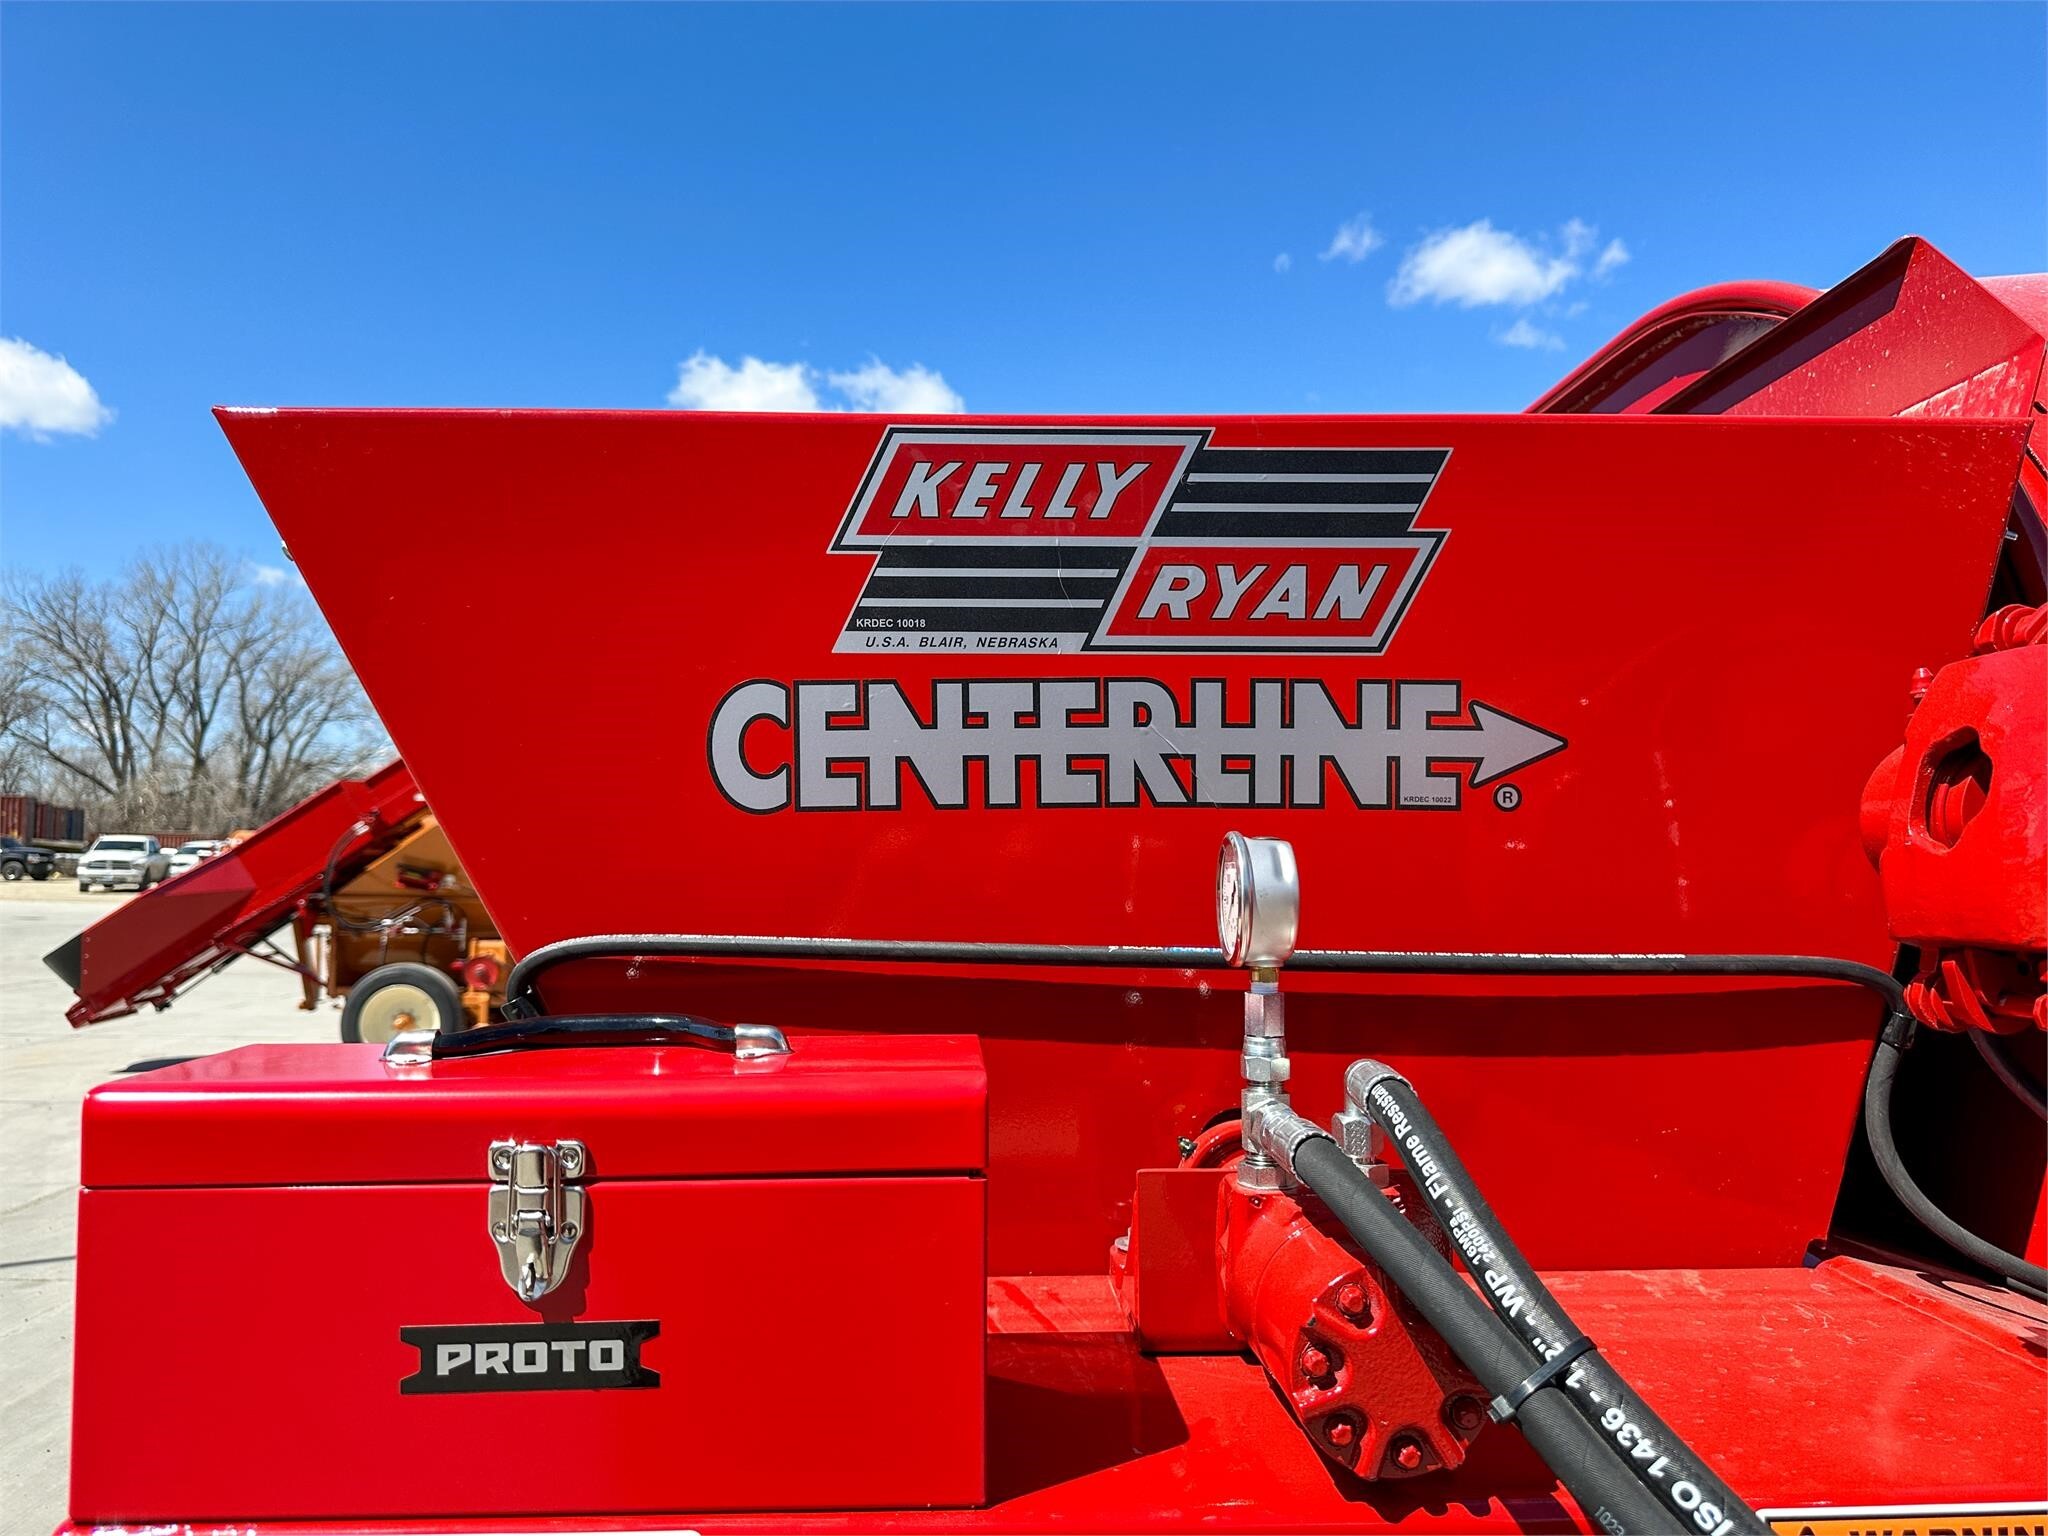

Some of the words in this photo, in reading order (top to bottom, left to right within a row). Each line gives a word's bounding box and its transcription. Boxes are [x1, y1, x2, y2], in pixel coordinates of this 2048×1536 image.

[890, 461, 1151, 518] KELLY
[1136, 564, 1389, 621] RYAN
[856, 618, 894, 628] KRDEC
[896, 618, 926, 628] 10018
[865, 636, 910, 648] U.S.A.
[918, 636, 968, 649] BLAIR,
[976, 637, 1059, 648] NEBRASKA
[705, 678, 1461, 815] CENTERLINE
[1403, 795, 1430, 803] KRDEC
[1406, 1135, 1450, 1200] Flame
[1449, 1216, 1482, 1265] 16MPa
[1453, 1207, 1497, 1263] 2400PSI
[1485, 1269, 1526, 1318] WP
[436, 1339, 625, 1377] PROTO
[1600, 1407, 1671, 1478] 1436
[1670, 1480, 1735, 1536] ISO
